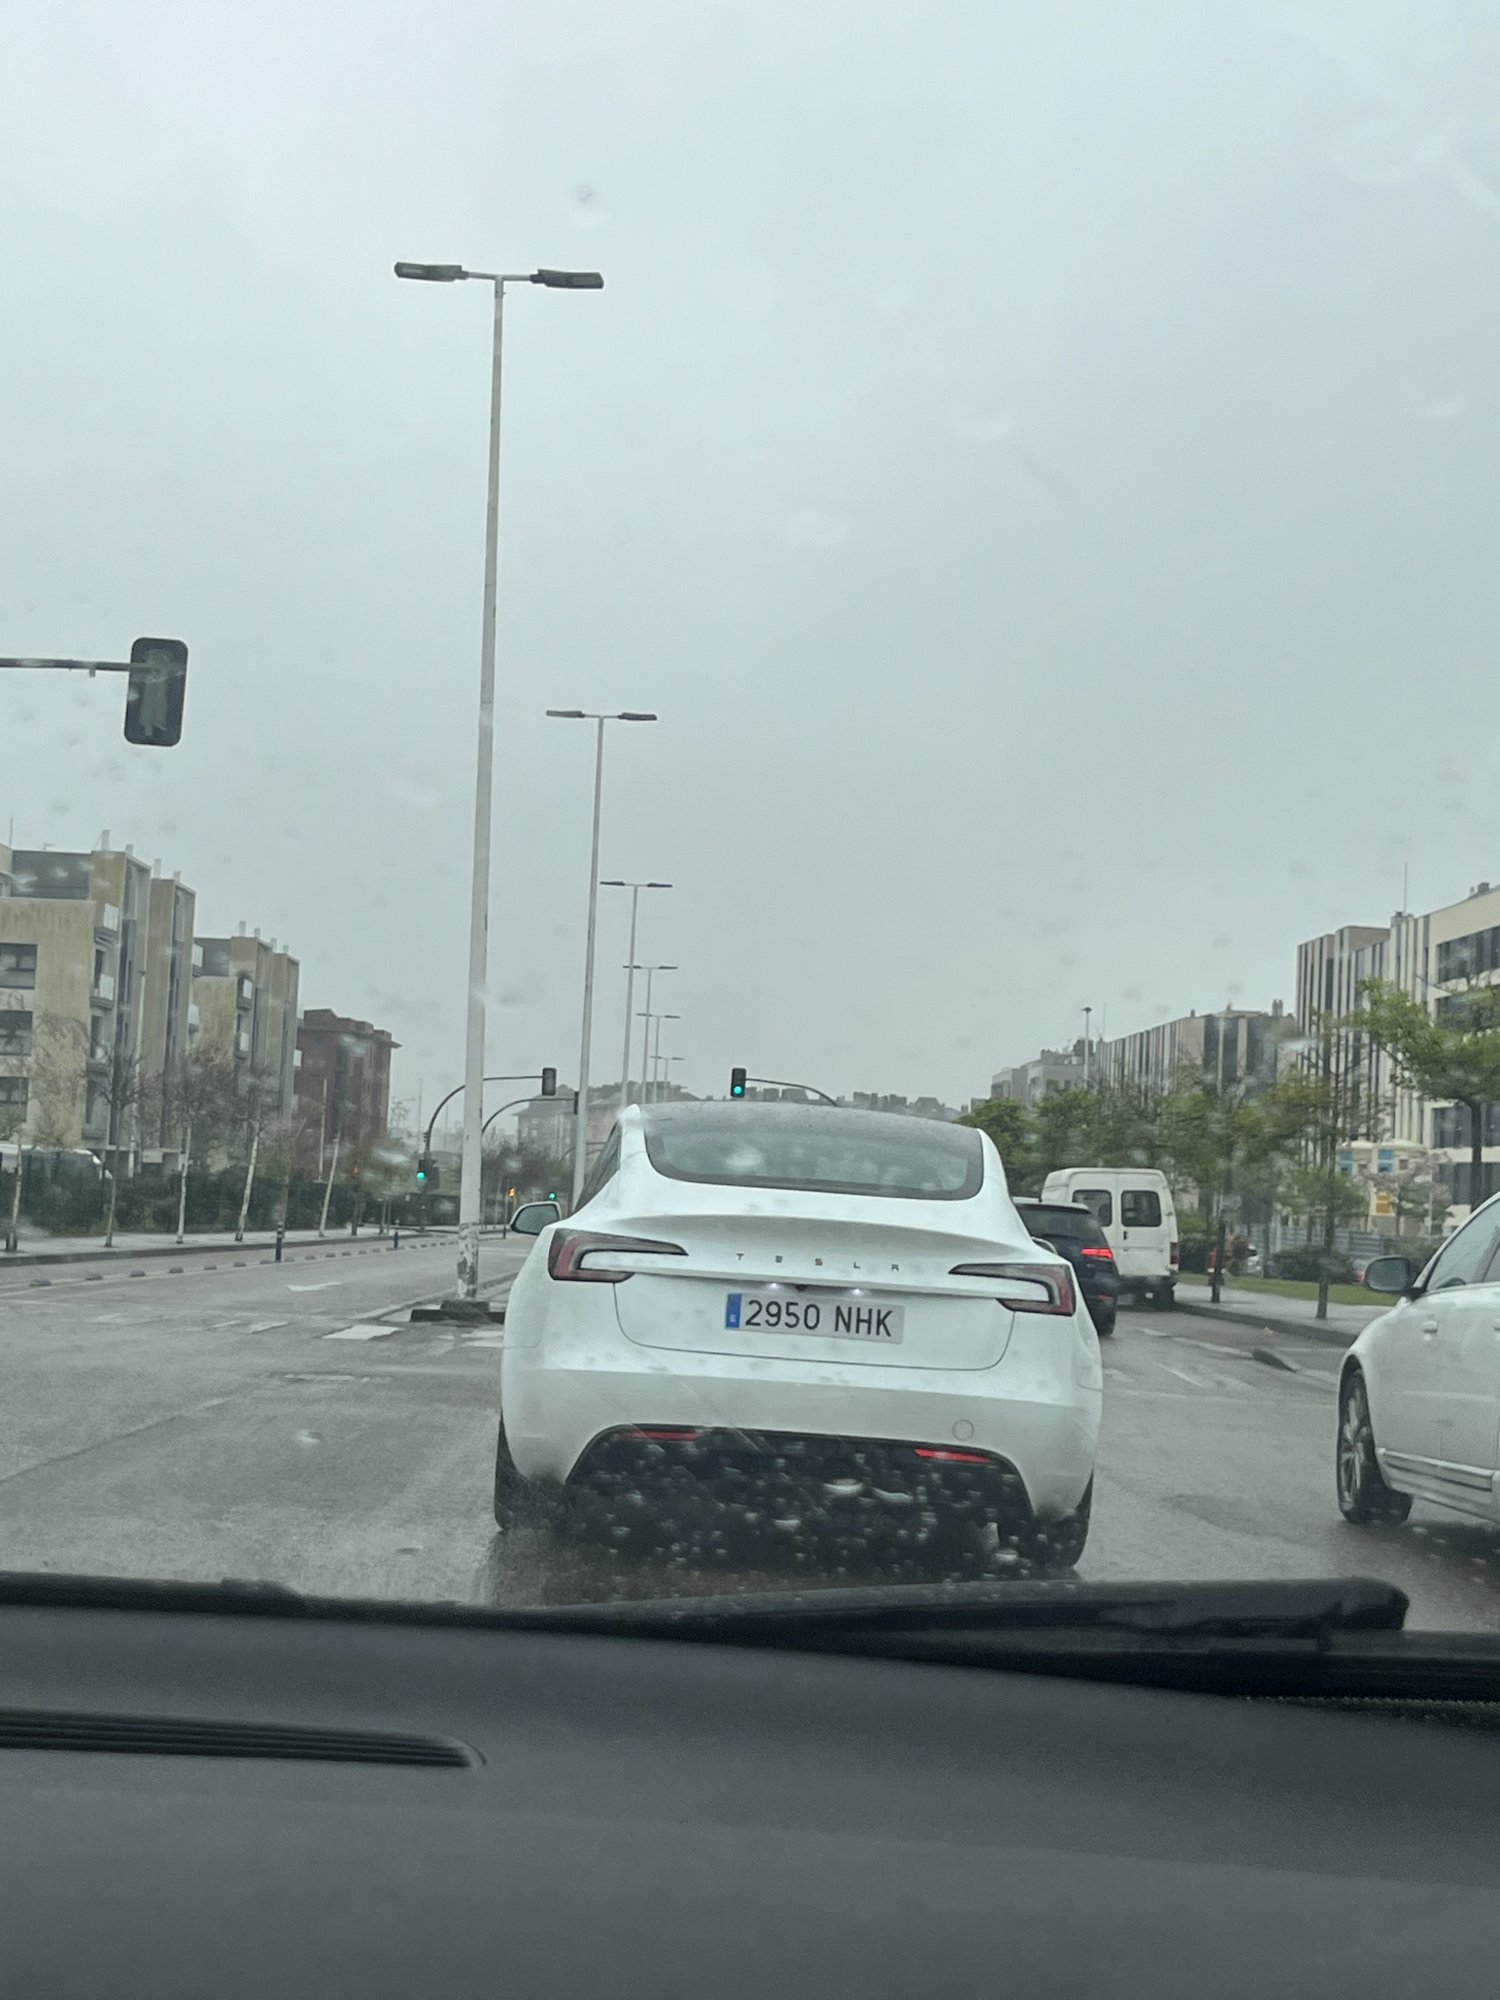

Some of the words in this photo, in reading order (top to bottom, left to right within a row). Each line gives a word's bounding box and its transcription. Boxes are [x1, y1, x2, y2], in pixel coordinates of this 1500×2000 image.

[736, 1253, 899, 1271] TESLA
[745, 1300, 820, 1330] 2950
[834, 1305, 893, 1337] NHK
